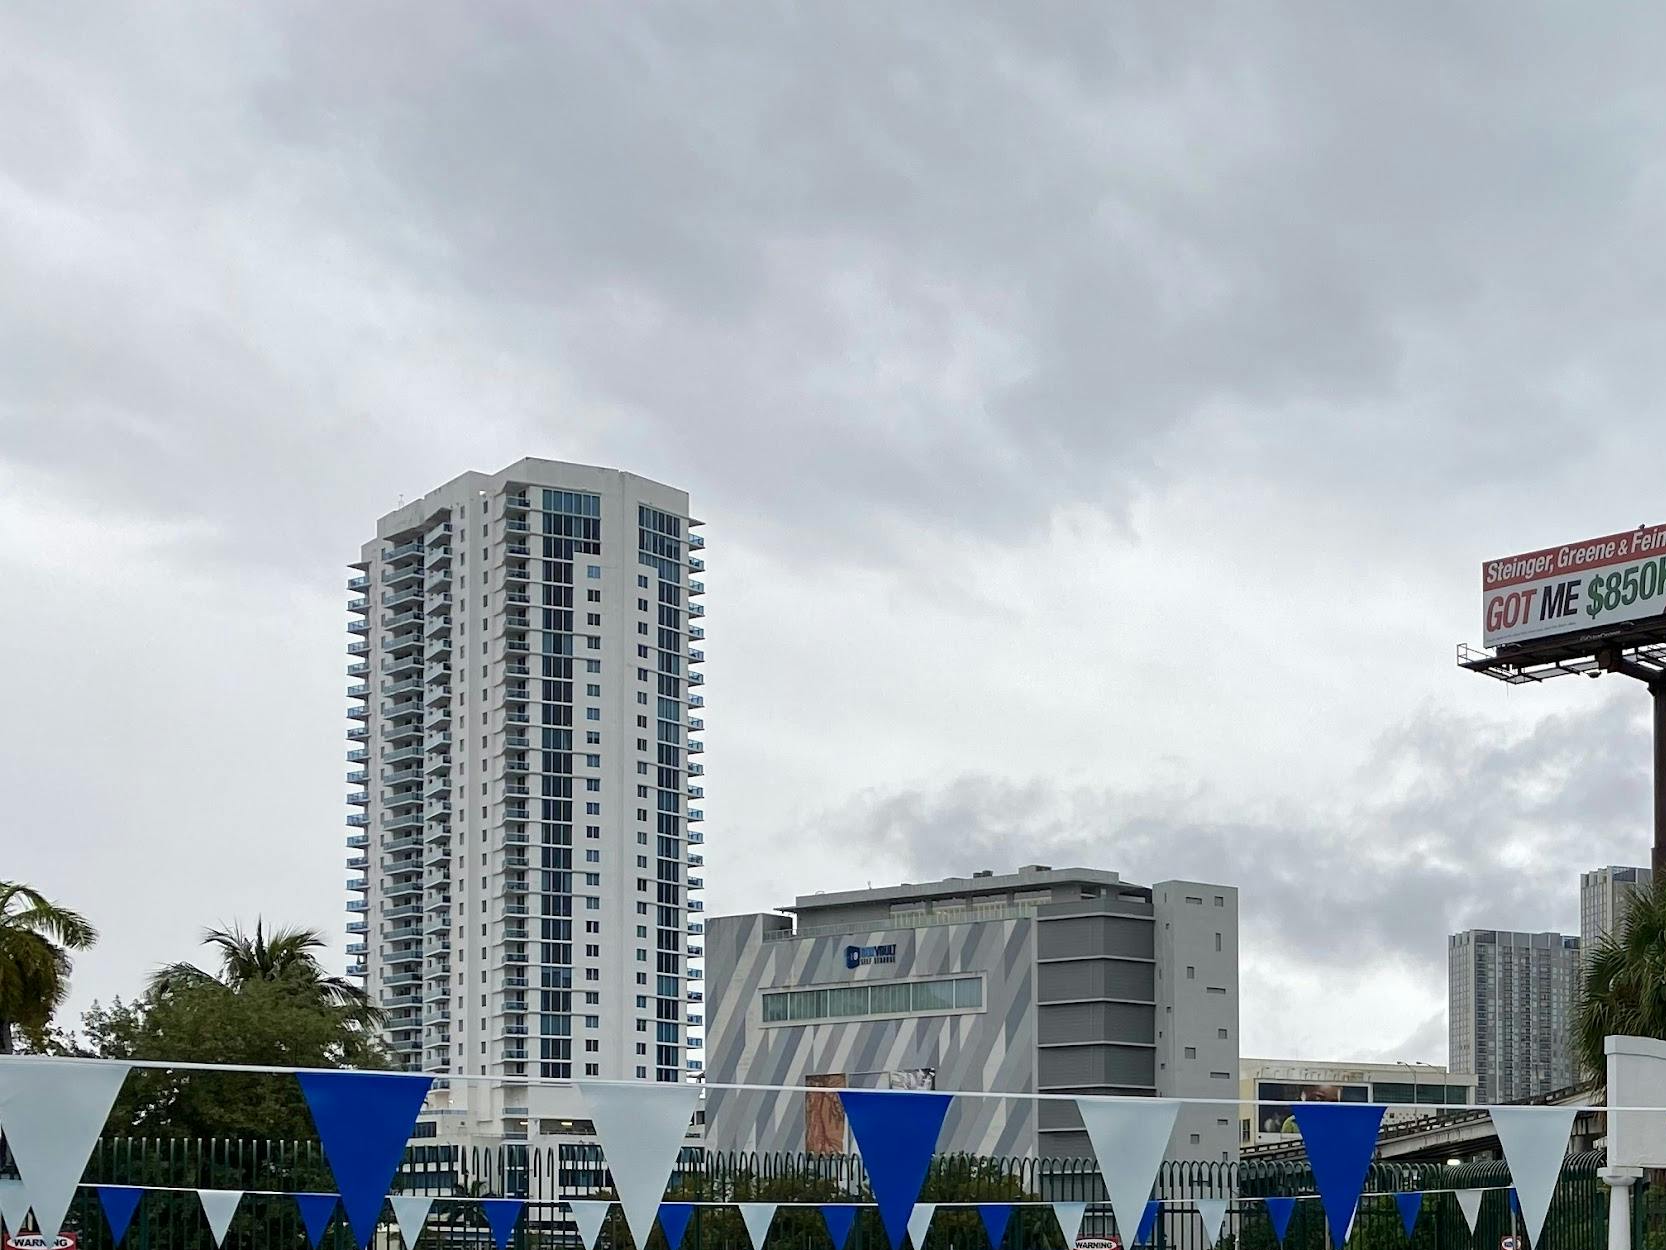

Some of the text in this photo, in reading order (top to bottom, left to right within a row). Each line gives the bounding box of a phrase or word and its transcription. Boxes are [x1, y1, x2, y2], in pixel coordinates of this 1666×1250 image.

[1486, 554, 1553, 584] Steinger,
[1557, 541, 1616, 568] Greene
[1617, 538, 1629, 555] &
[1486, 588, 1537, 633] GOT
[1539, 579, 1582, 621] ME
[14, 1238, 68, 1247] WARNNG
[1075, 1241, 1113, 1249] WARNING
